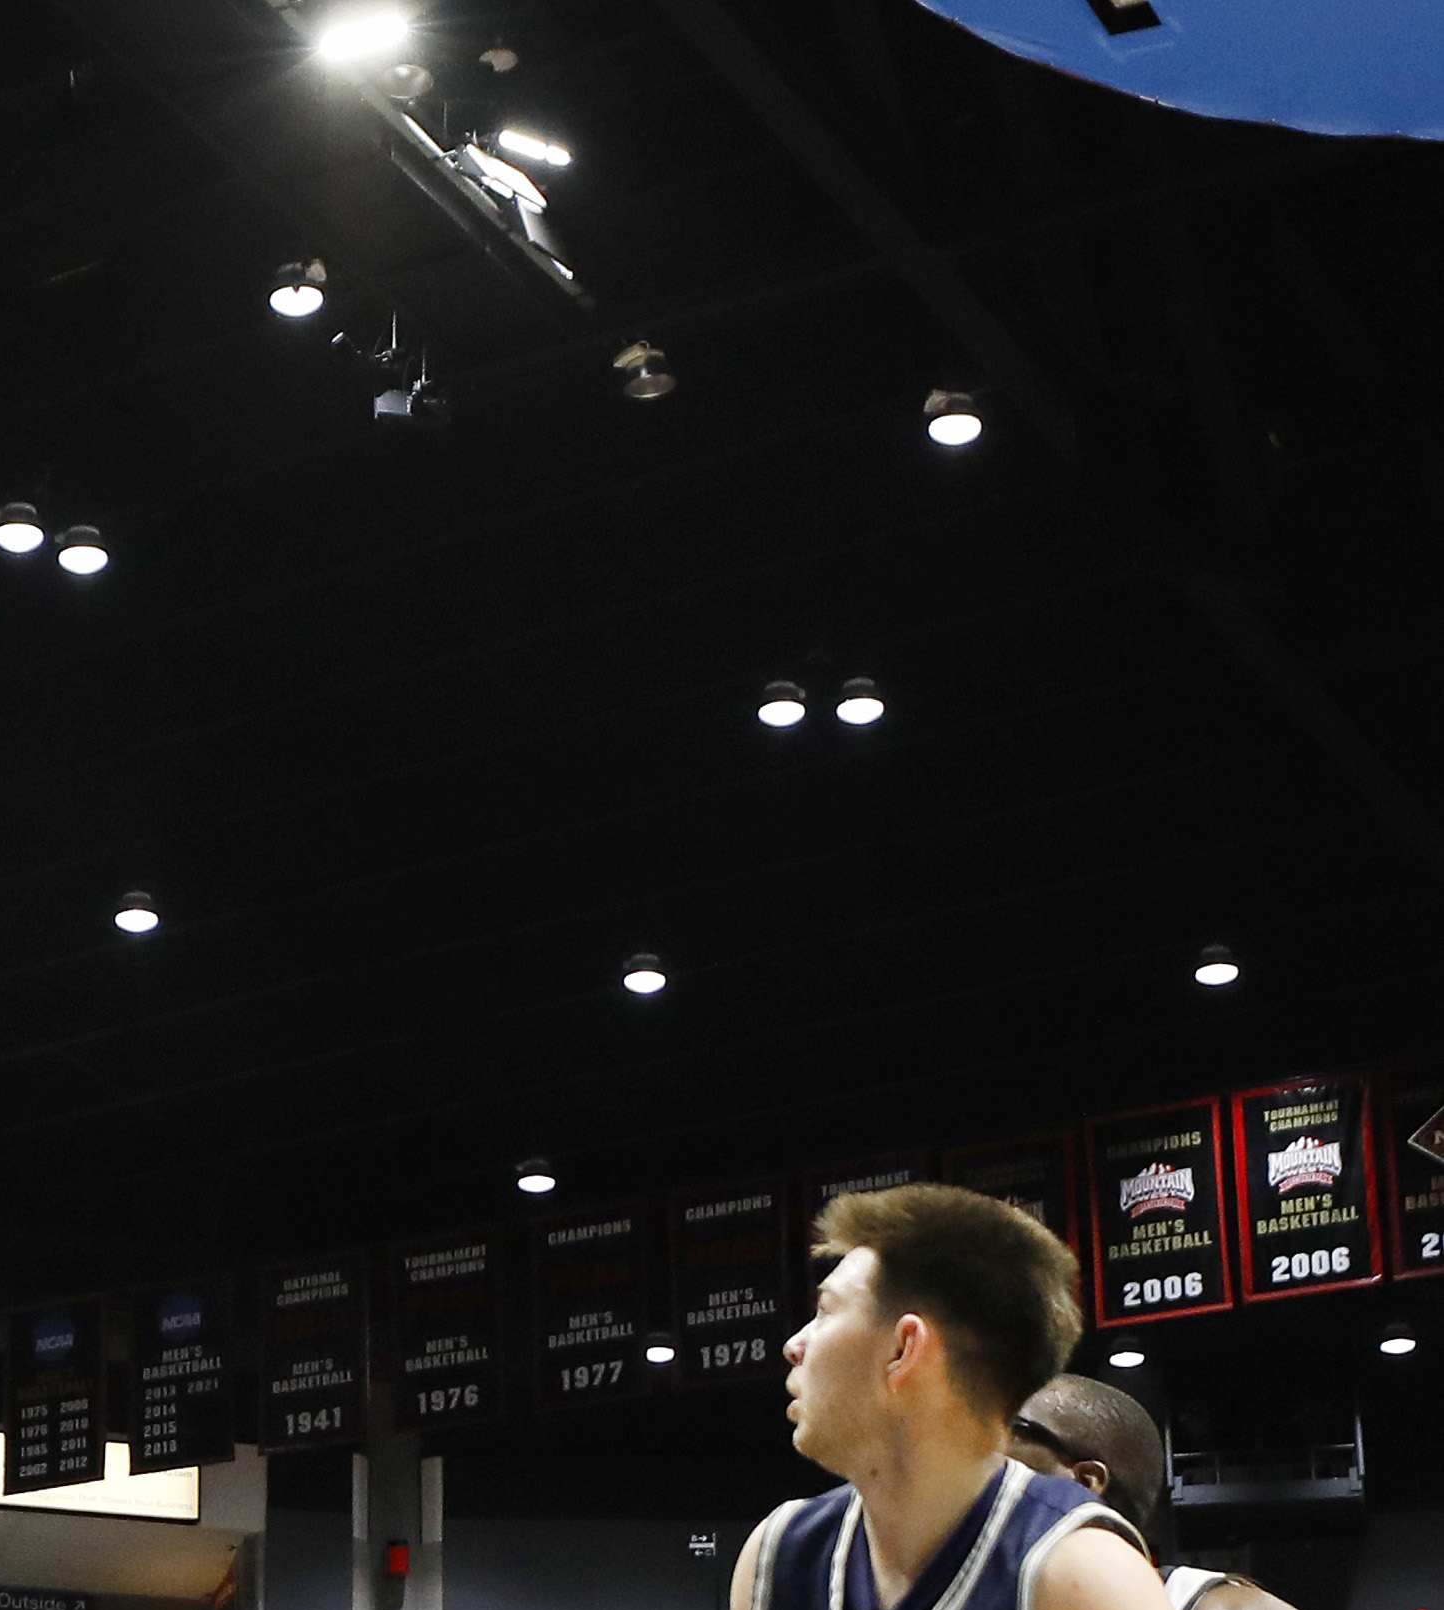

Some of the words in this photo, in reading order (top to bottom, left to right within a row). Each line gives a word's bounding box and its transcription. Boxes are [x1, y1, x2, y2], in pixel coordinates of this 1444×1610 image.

[1263, 1099, 1340, 1122] TOURNAMENT
[1269, 1110, 1339, 1134] CHAMPIONS
[1106, 1130, 1203, 1159] CHAMPIONS
[1267, 1141, 1343, 1187] MOUNTAIN
[1119, 1167, 1196, 1212] MOUNTAIN
[685, 1195, 773, 1222] CHAMPIONS
[1280, 1192, 1334, 1215] MEN'S
[547, 1218, 632, 1246] CHAMPIONS
[1132, 1218, 1186, 1240] MEN'S
[1255, 1204, 1360, 1236] BASKETBALL
[404, 1244, 487, 1271] TOURNAMENT
[1107, 1229, 1213, 1260] BASKETBALL
[410, 1258, 486, 1283] CHAMPIONS
[1270, 1245, 1352, 1284] 2006
[276, 1283, 350, 1307] CHAMPIONS
[283, 1271, 342, 1292] NATIONAL
[1122, 1271, 1204, 1308] 2006
[708, 1287, 754, 1307] MEN'S
[568, 1310, 614, 1330] MEN'S
[686, 1299, 777, 1326] BASKETBALL
[425, 1335, 469, 1354] MEN'S
[547, 1322, 634, 1349] BASKETBALL
[162, 1345, 204, 1363] MEN'S
[292, 1358, 335, 1376] MEN'S
[404, 1346, 489, 1373] BASKETBALL
[699, 1338, 767, 1370] 1978
[142, 1355, 223, 1381] BASKETBALL
[561, 1358, 624, 1392] 1977
[272, 1369, 353, 1395] BASKETBALL
[144, 1402, 177, 1420] 2014
[417, 1383, 480, 1414] 1976
[144, 1421, 177, 1438] 2015
[285, 1406, 342, 1436] 1941
